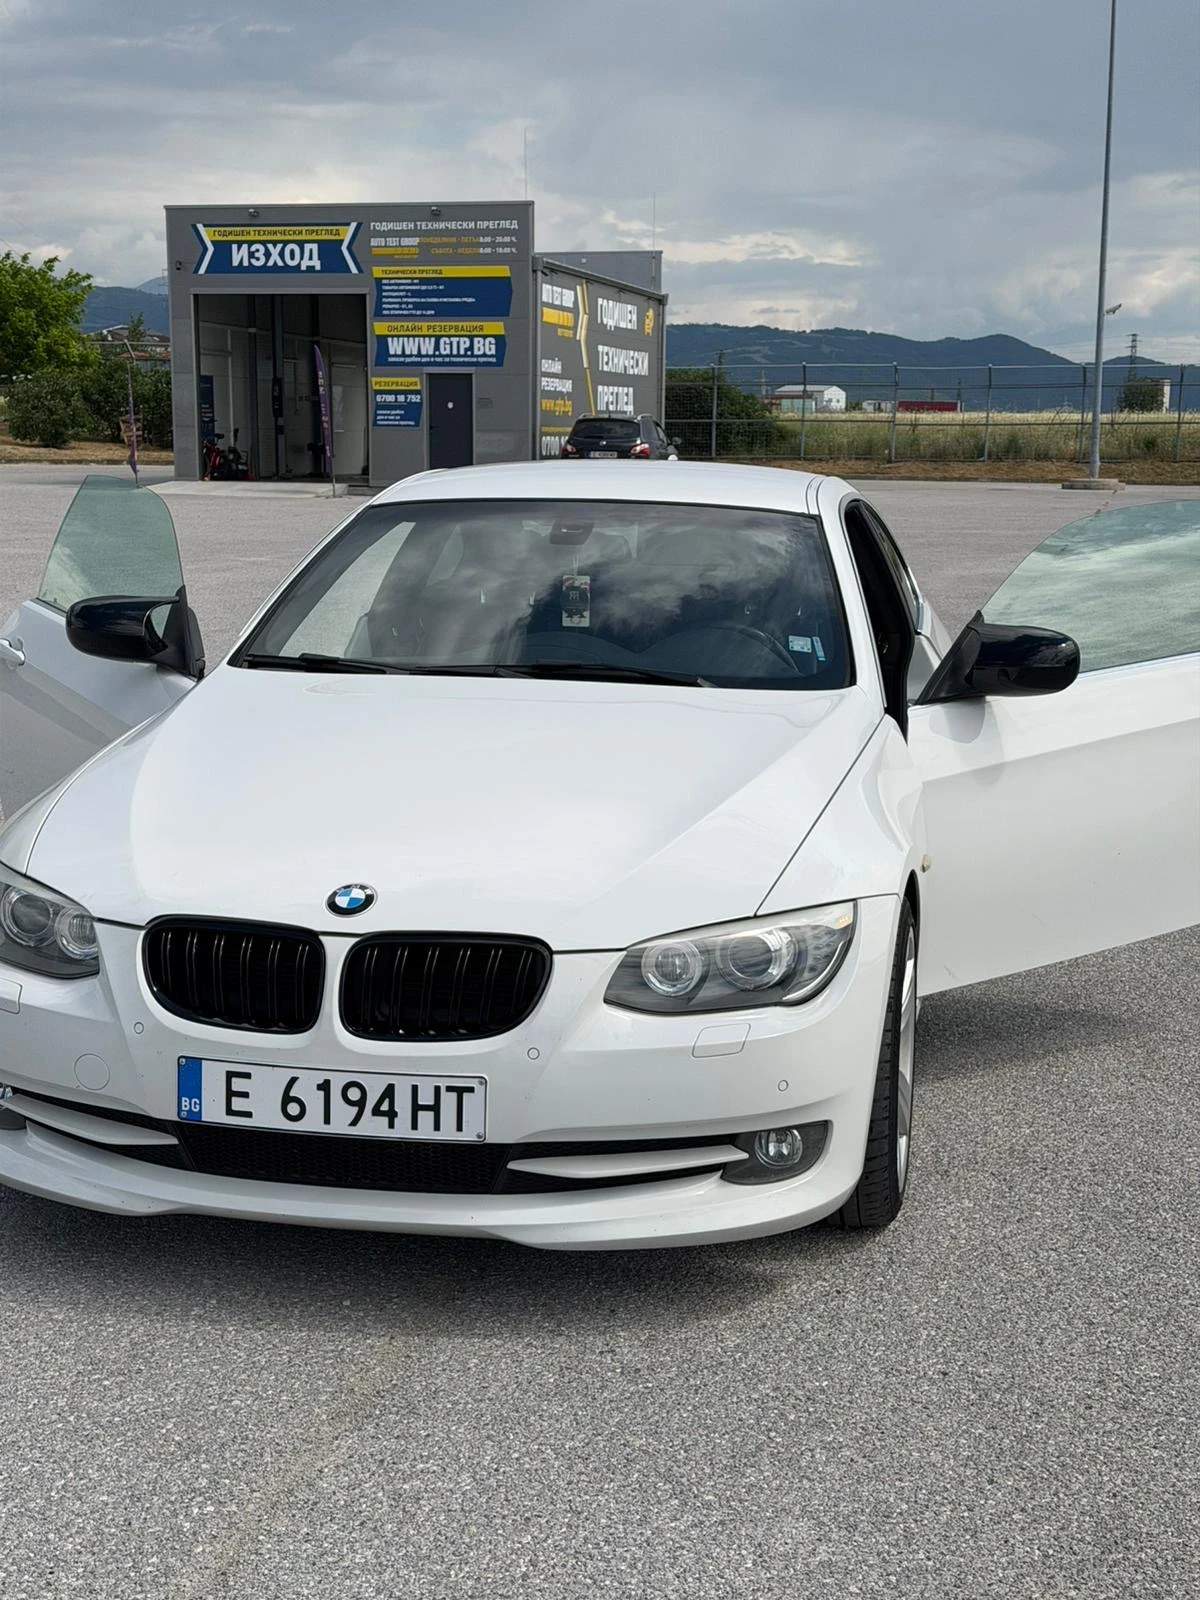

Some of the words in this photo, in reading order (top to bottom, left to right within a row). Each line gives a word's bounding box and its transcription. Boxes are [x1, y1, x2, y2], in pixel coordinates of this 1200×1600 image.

[212, 228, 250, 238] ГОДИШЕН
[252, 228, 303, 237] ТЕХНИЧЕСКИ
[305, 227, 341, 237] ПРЕГЛЕД
[370, 221, 414, 231] ГОДИШЕН
[416, 220, 475, 230] ТЕХНИЧЕСКИ
[477, 219, 518, 229] ПРЕГЛЕД
[386, 237, 400, 246] TEST
[231, 243, 321, 270] ИЗХОД
[597, 298, 637, 331] ГОДИШЕН
[387, 323, 423, 333] ОНЛАЙН
[426, 324, 484, 333] РЕЗЕРВАЦИЯ
[387, 337, 496, 355] WWW.GTP.BG
[541, 358, 562, 374] ОНЛАЙН
[598, 345, 649, 376] ТЕХНИЧЕСКИ
[374, 380, 418, 388] РЕЗЕРВАЦИЯ
[406, 394, 421, 402] 752
[597, 385, 634, 416] ПРЕГЛЕД
[181, 1097, 200, 1112] BG
[225, 1070, 253, 1118] E
[280, 1076, 475, 1132] 6194HT
